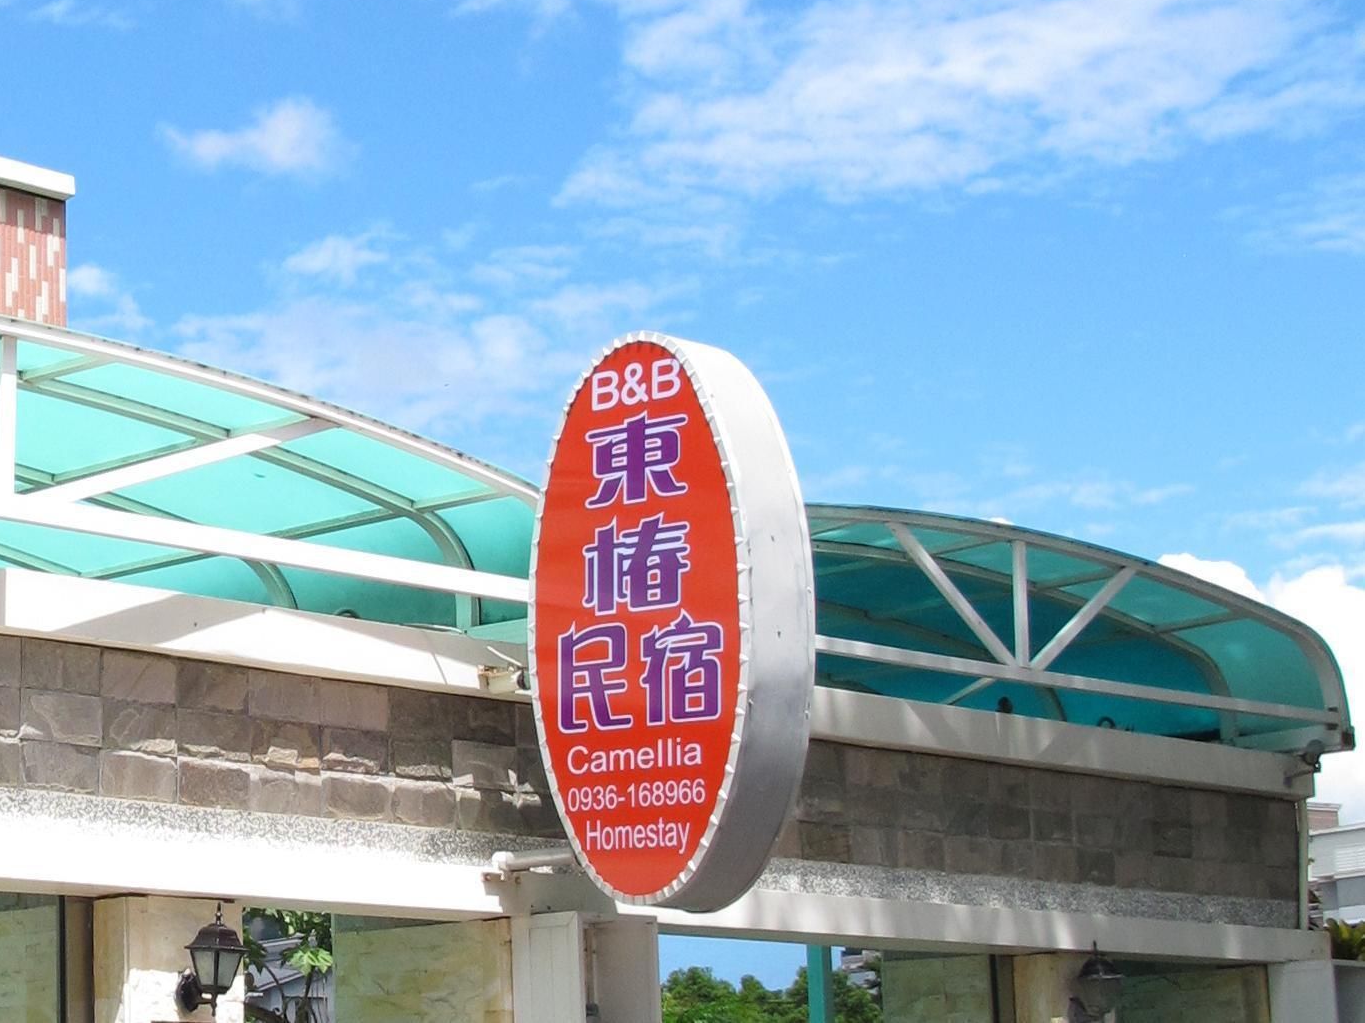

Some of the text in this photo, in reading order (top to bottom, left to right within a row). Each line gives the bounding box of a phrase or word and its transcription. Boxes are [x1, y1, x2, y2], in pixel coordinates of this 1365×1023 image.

[591, 358, 682, 412] B&B
[567, 737, 702, 775] Camellia
[567, 778, 706, 812] 0936-168966
[586, 817, 690, 855] Homestay
